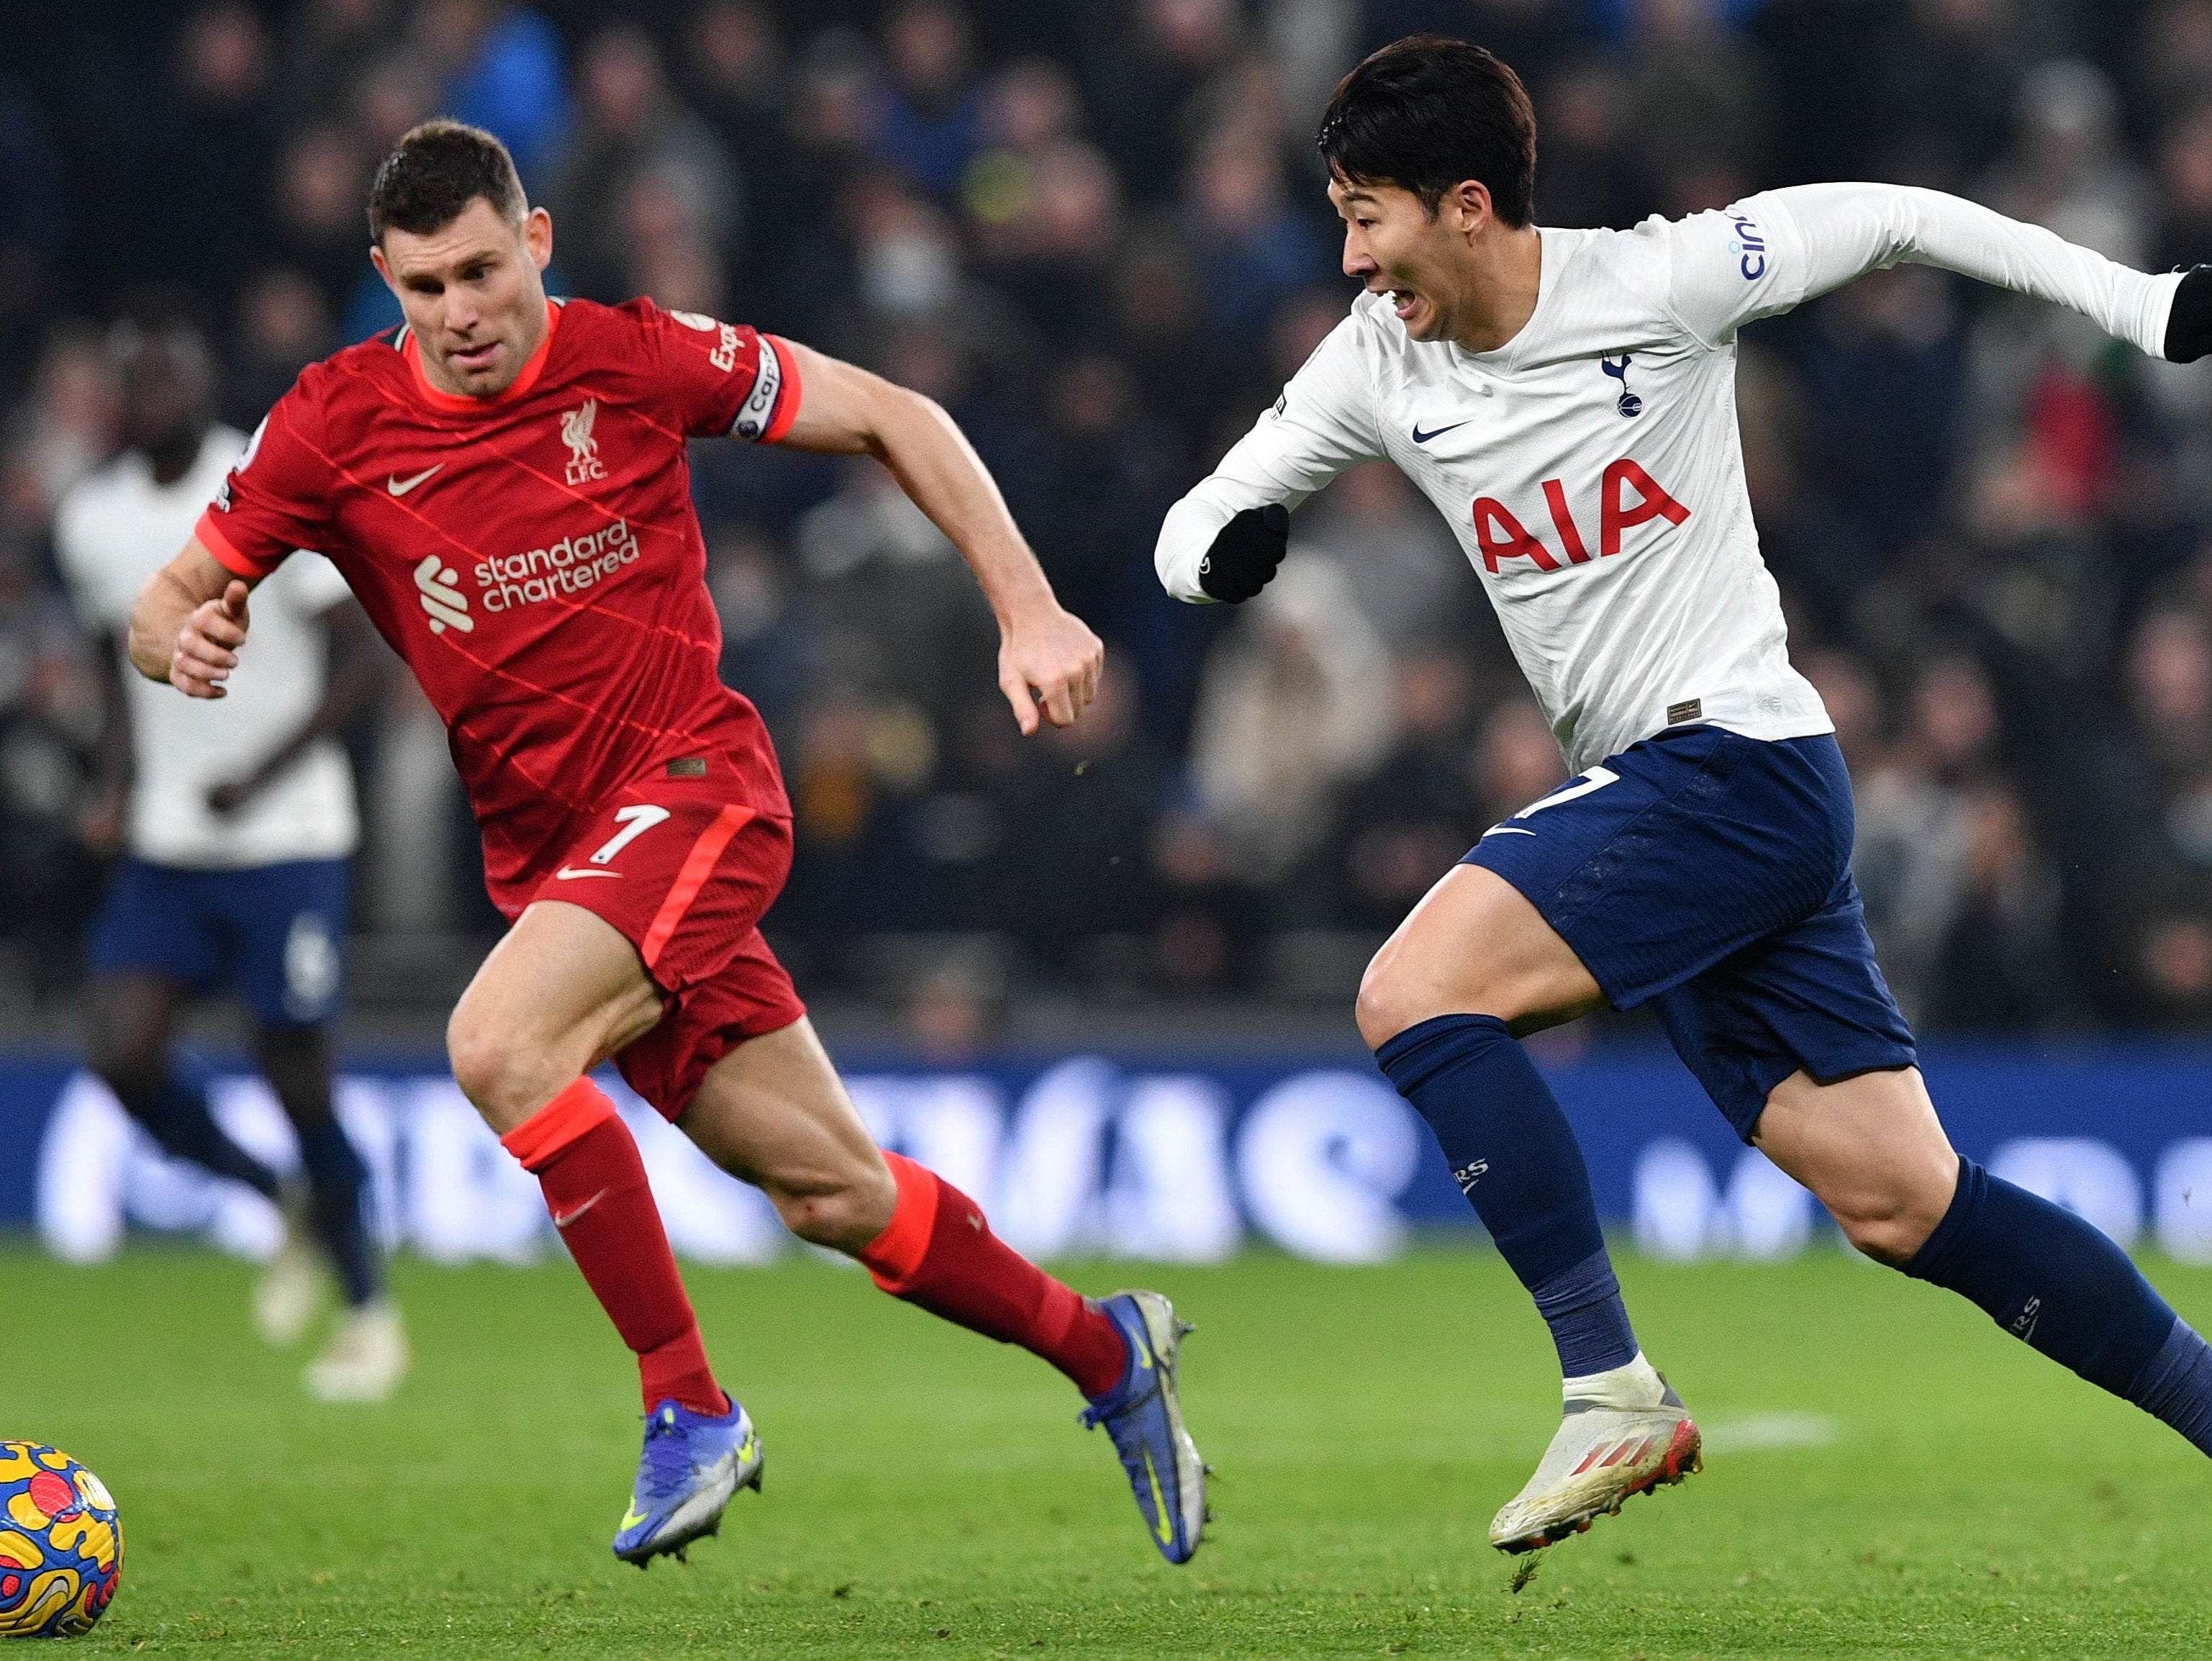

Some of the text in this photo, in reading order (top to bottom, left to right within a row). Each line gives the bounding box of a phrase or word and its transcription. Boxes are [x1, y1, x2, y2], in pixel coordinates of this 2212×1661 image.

[1728, 215, 1766, 281] cin
[1472, 458, 1692, 574] AIA
[473, 517, 628, 587] standard
[482, 534, 640, 612] chartered
[1513, 765, 1621, 820] 7
[589, 804, 671, 864] 7
[1453, 1157, 1489, 1184] RS
[2010, 1295, 2041, 1332] RS
